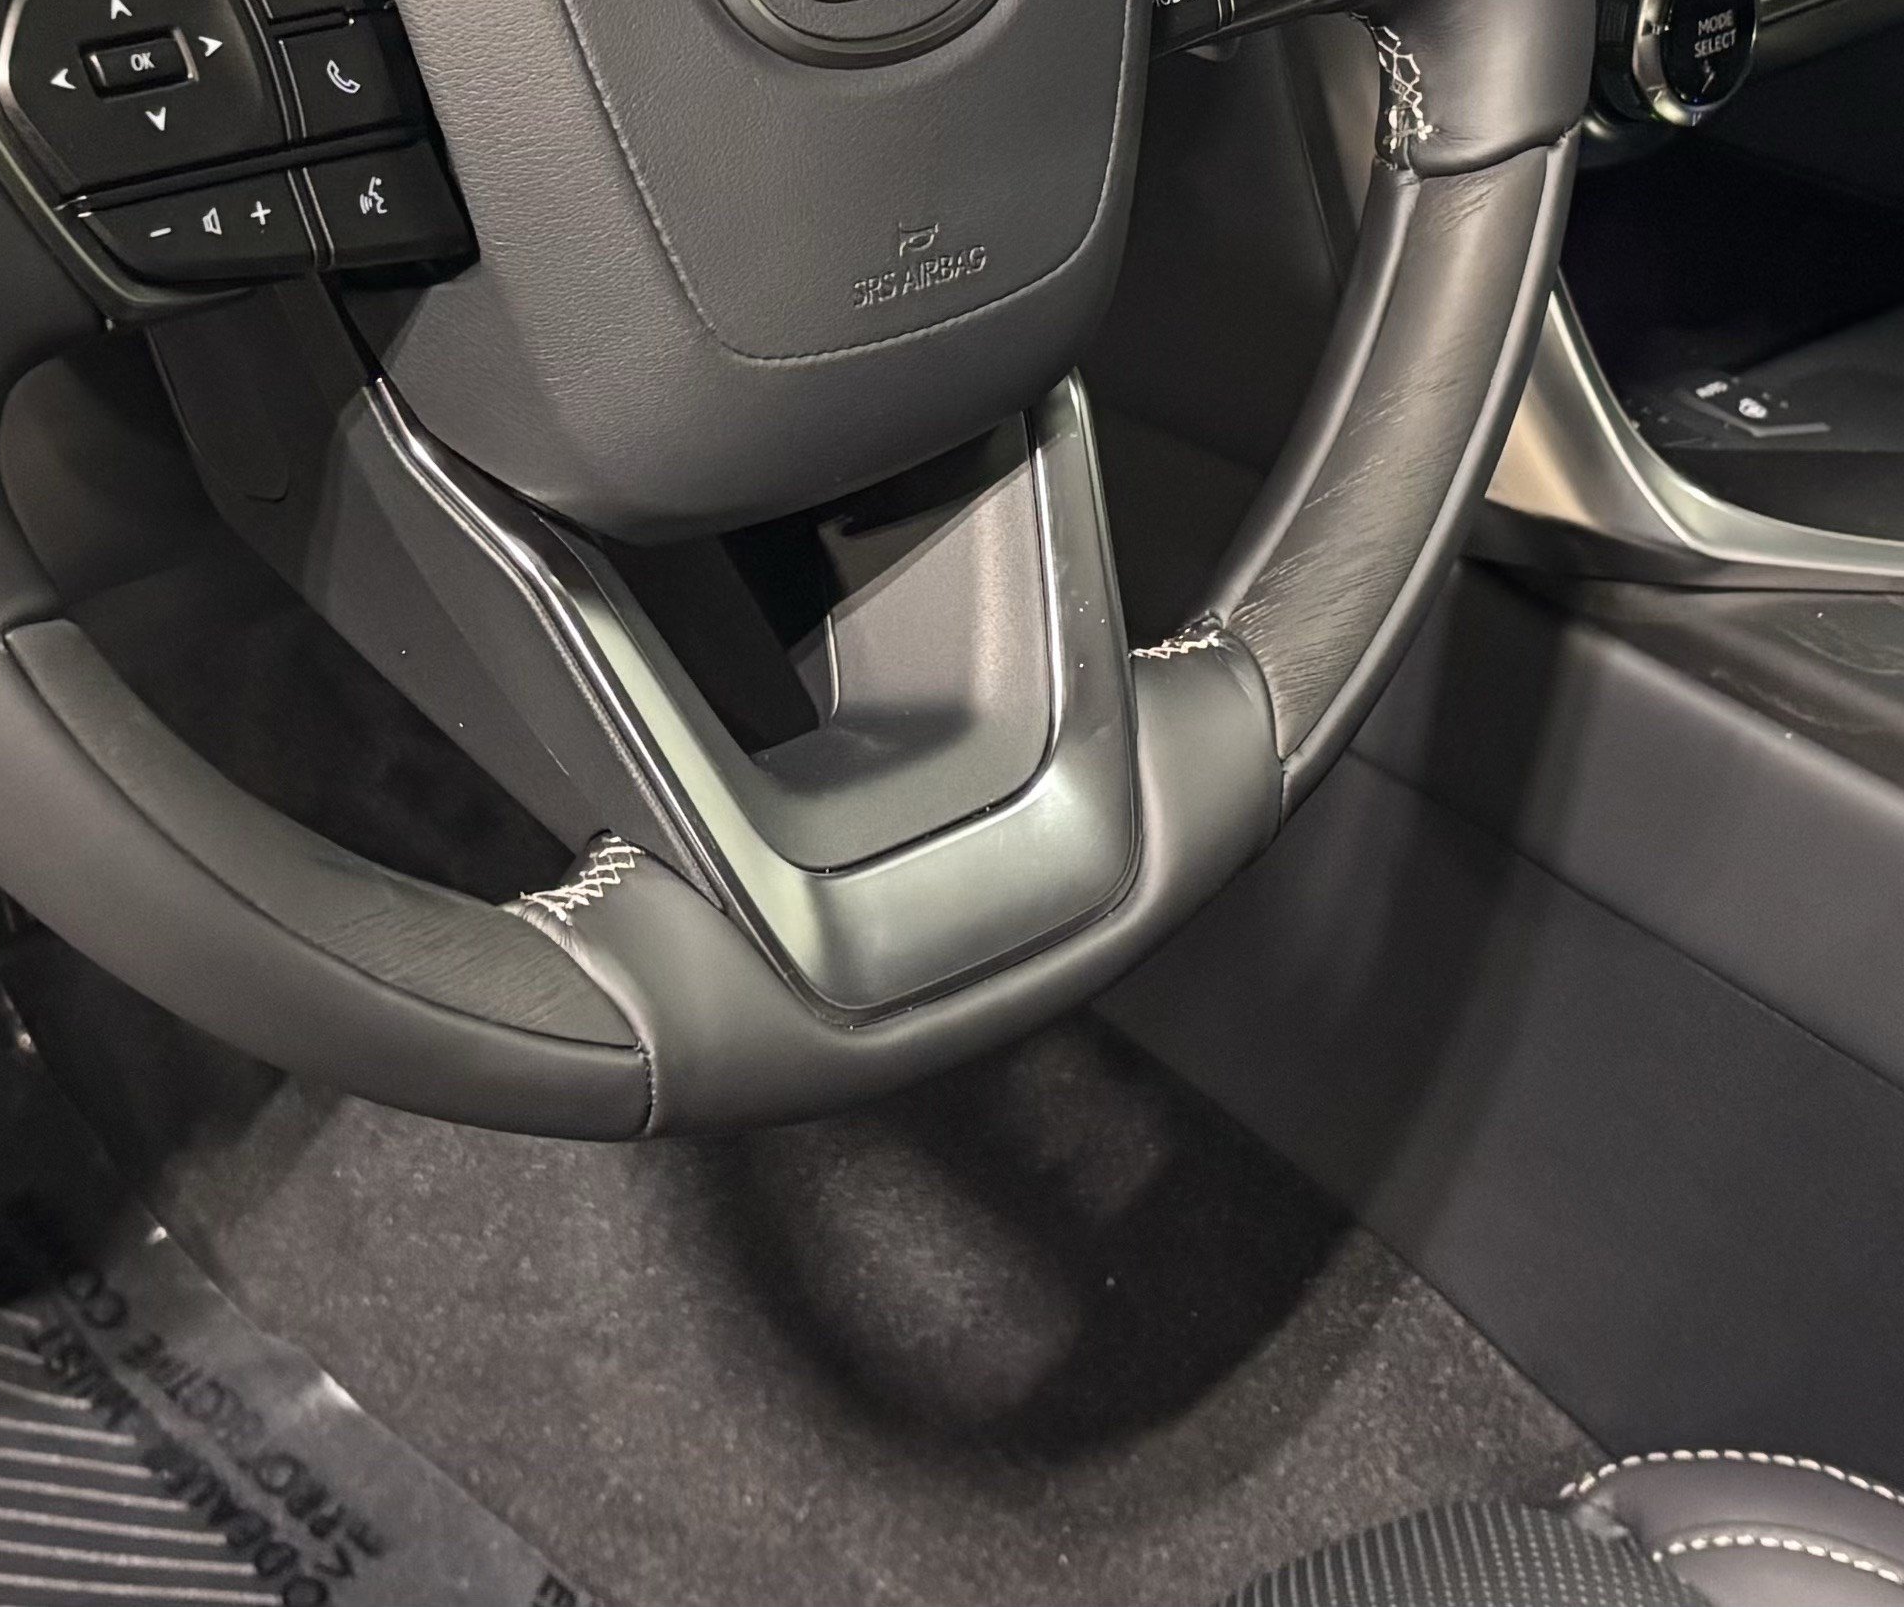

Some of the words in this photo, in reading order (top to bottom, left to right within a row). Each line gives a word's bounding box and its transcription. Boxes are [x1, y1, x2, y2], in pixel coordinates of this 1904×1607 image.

[1698, 8, 1735, 36] MODE
[1694, 28, 1738, 60] SELECT
[129, 52, 156, 72] OK
[901, 244, 988, 296] AIRBAG
